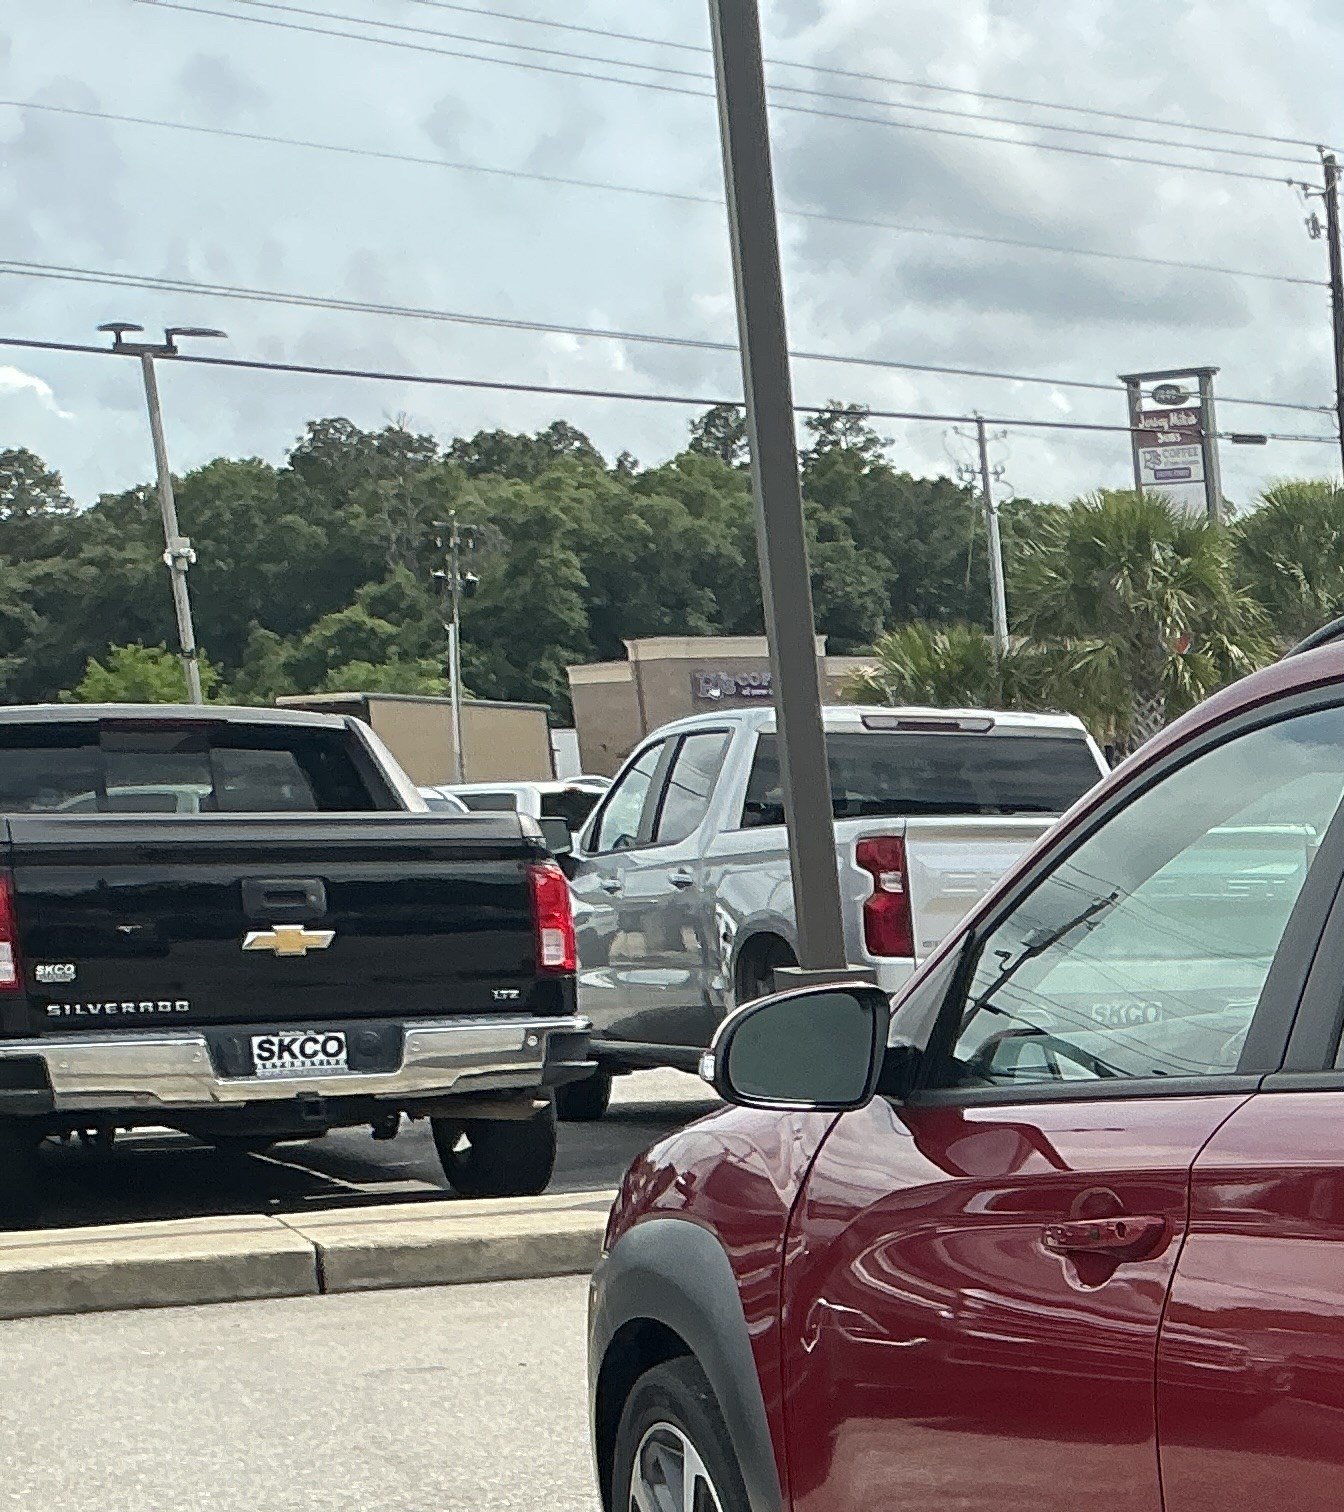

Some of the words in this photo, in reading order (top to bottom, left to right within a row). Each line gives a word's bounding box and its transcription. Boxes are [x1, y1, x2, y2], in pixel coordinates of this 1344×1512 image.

[36, 964, 75, 975] SKCO
[47, 1001, 190, 1016] SILVERADO
[256, 1036, 344, 1062] SKCO
